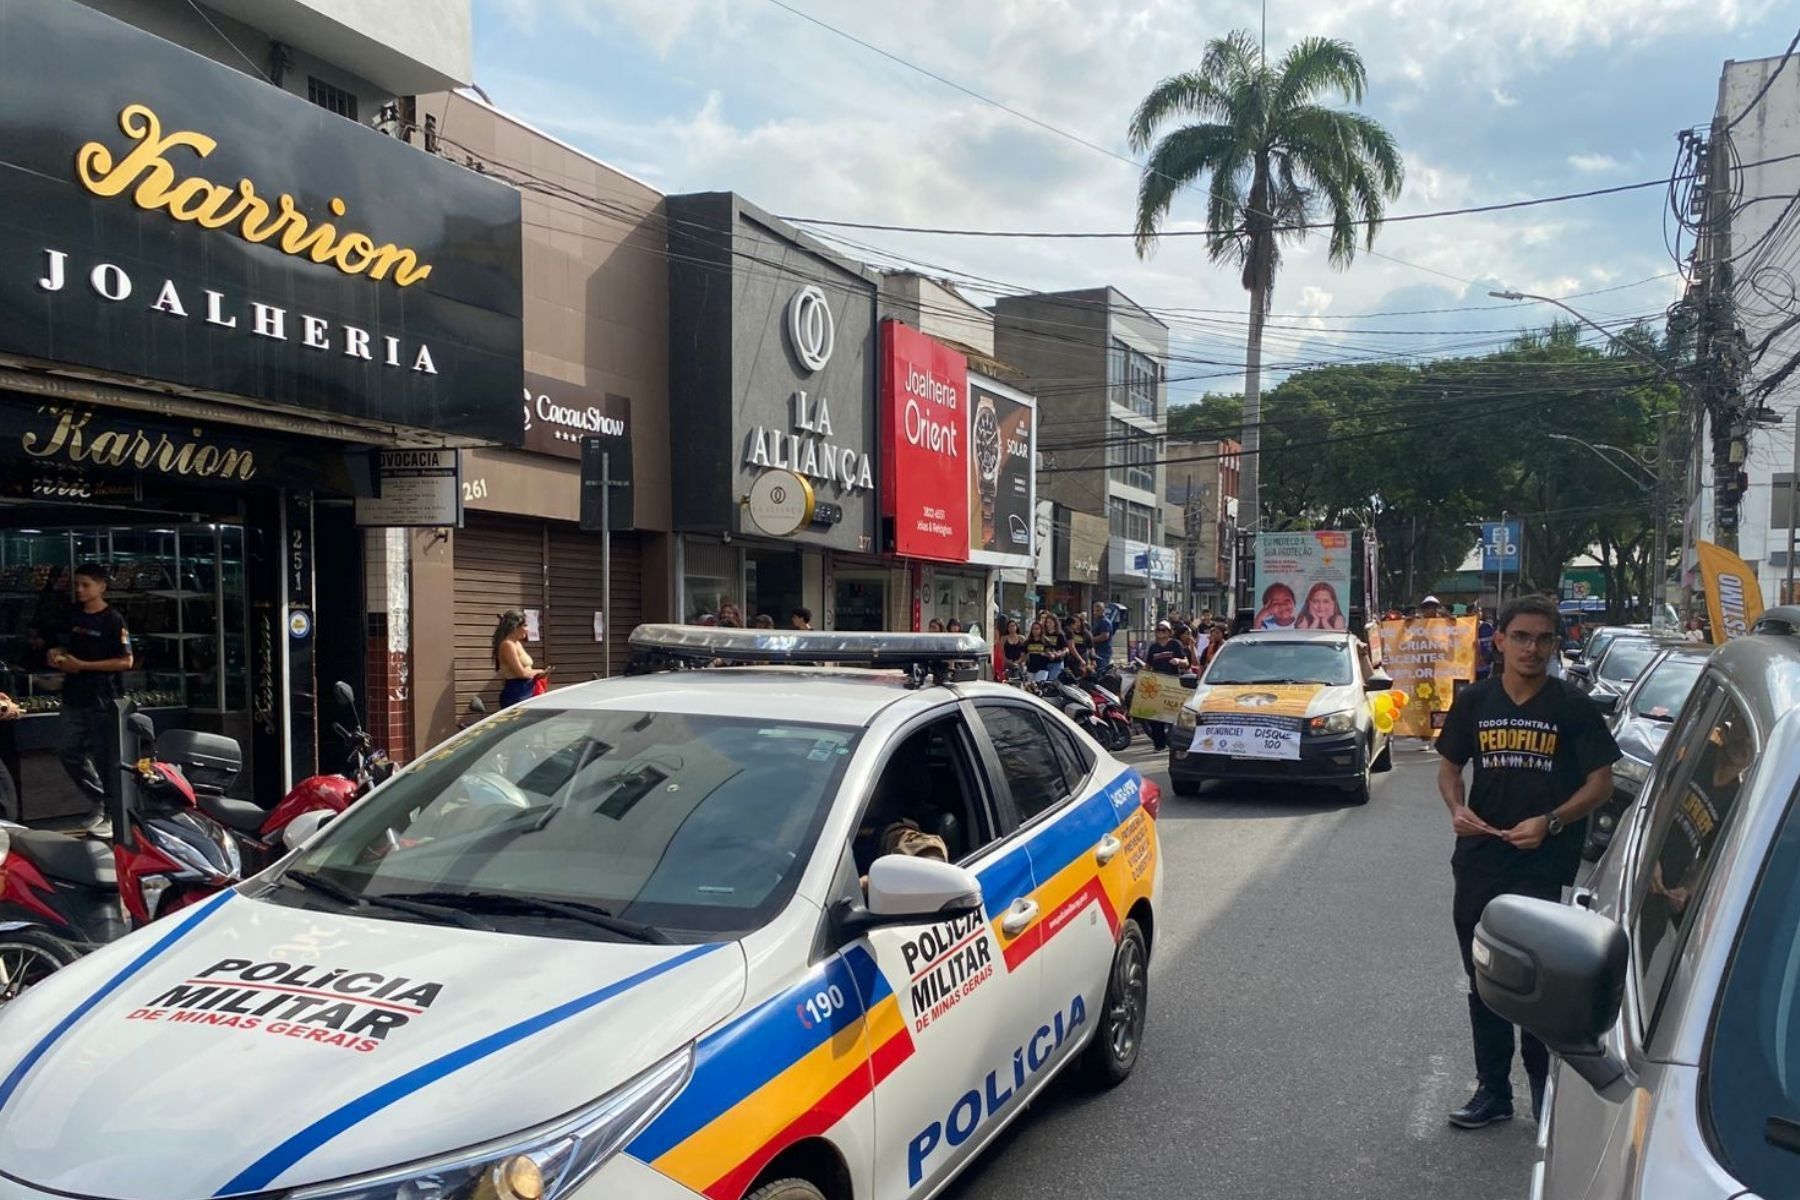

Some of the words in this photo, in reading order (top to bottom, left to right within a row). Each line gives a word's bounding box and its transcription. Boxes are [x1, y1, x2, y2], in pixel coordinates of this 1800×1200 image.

[77, 104, 432, 286] Karrion
[38, 248, 439, 375] JOALHERIA
[904, 363, 957, 410] Joalheria
[795, 391, 833, 437] LA
[904, 400, 958, 457] Orient
[22, 406, 257, 481] Karrion
[378, 452, 440, 468] DVOCACIA
[748, 425, 874, 491] ALIANÇA
[1007, 439, 1028, 459] SOLAR
[462, 478, 488, 501] 261
[1254, 728, 1293, 740] DISQUE
[1264, 740, 1281, 749] 100
[1479, 719, 1508, 729] TODOS
[1510, 719, 1550, 731] CONTRA
[1552, 724, 1558, 732] A
[1479, 729, 1557, 755] PEDOFILIA
[195, 958, 444, 1008] POLÍCIA
[911, 936, 991, 1017] MILITAR
[915, 1013, 930, 1034] DE
[931, 989, 961, 1022] MINAS
[962, 964, 993, 997] GERAIS
[145, 985, 410, 1040] MILITAR
[805, 984, 844, 1026] 190
[125, 1008, 169, 1021] DE
[168, 1010, 263, 1029] MINAS
[264, 1021, 379, 1052] GERAIS
[907, 994, 1087, 1189] POLÍCIA
